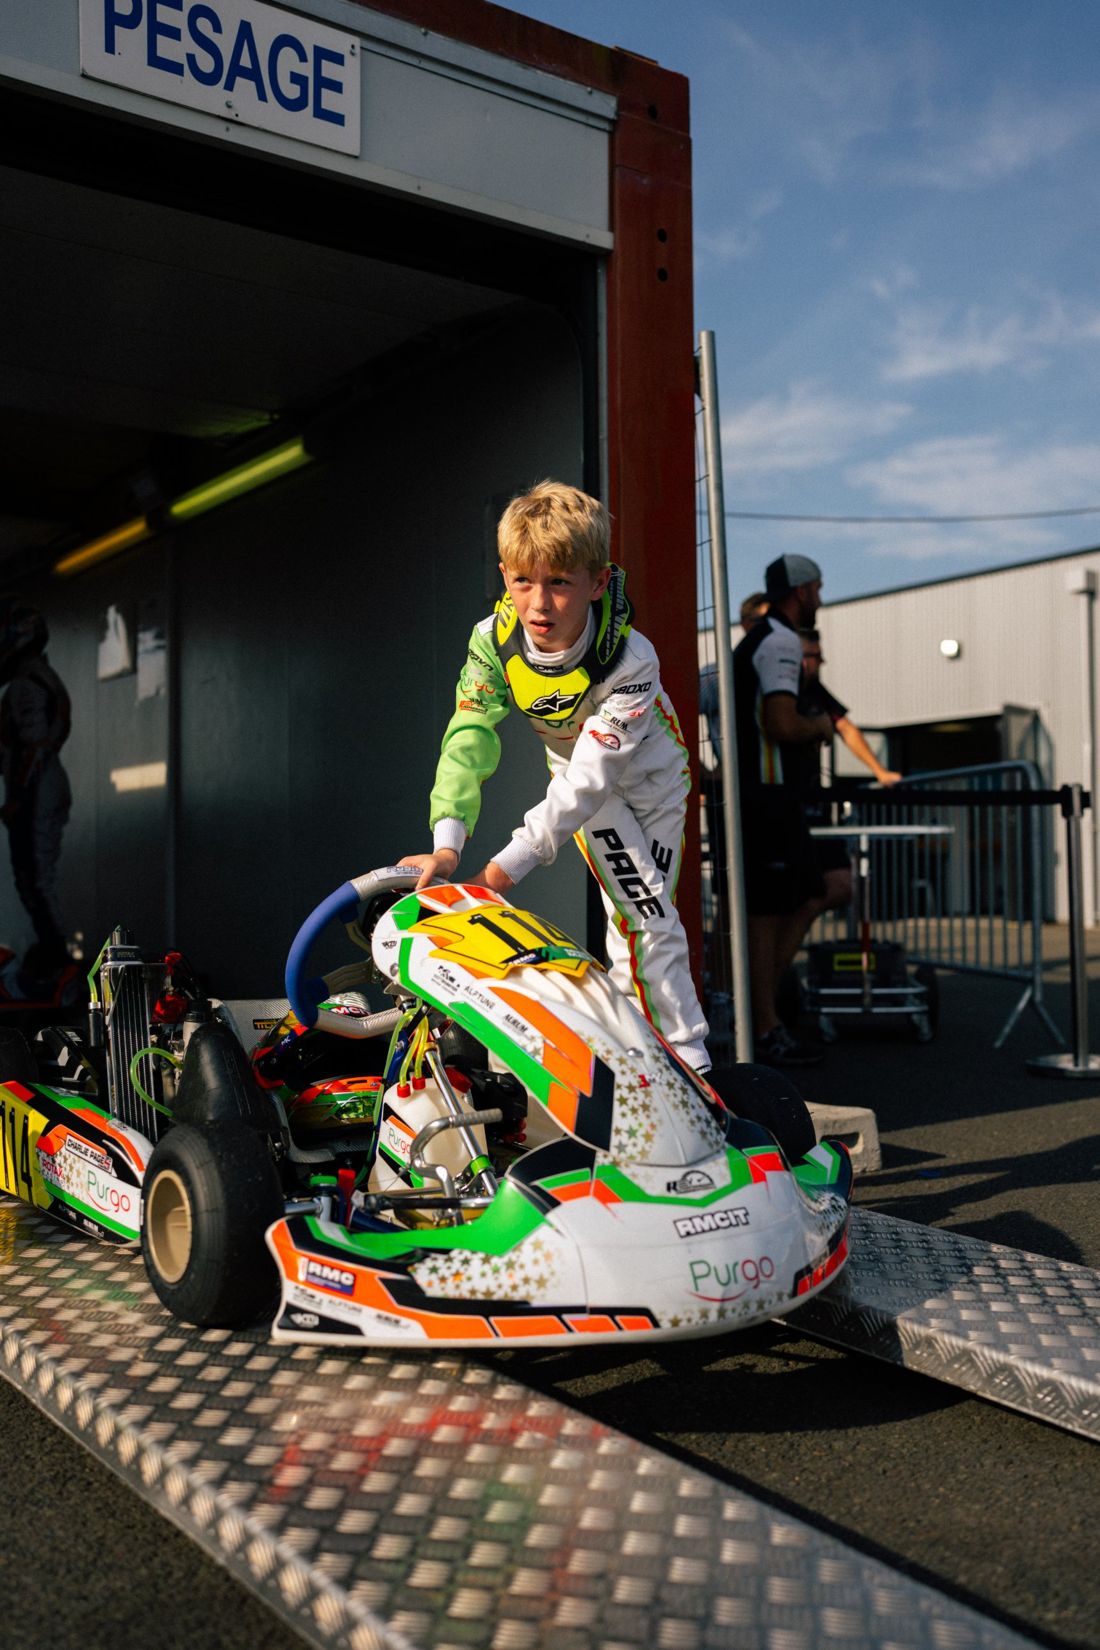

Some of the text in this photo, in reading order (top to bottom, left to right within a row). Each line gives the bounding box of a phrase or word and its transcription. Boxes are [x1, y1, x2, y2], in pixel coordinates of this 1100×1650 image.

[104, 0, 345, 127] PESAGE
[592, 828, 665, 919] PAGE
[67, 1138, 90, 1158] CHARLIE
[87, 1170, 131, 1213] Purgo
[674, 1207, 749, 1238] RMCIT
[308, 1260, 355, 1287] RMC
[689, 1256, 774, 1292] Purgo
